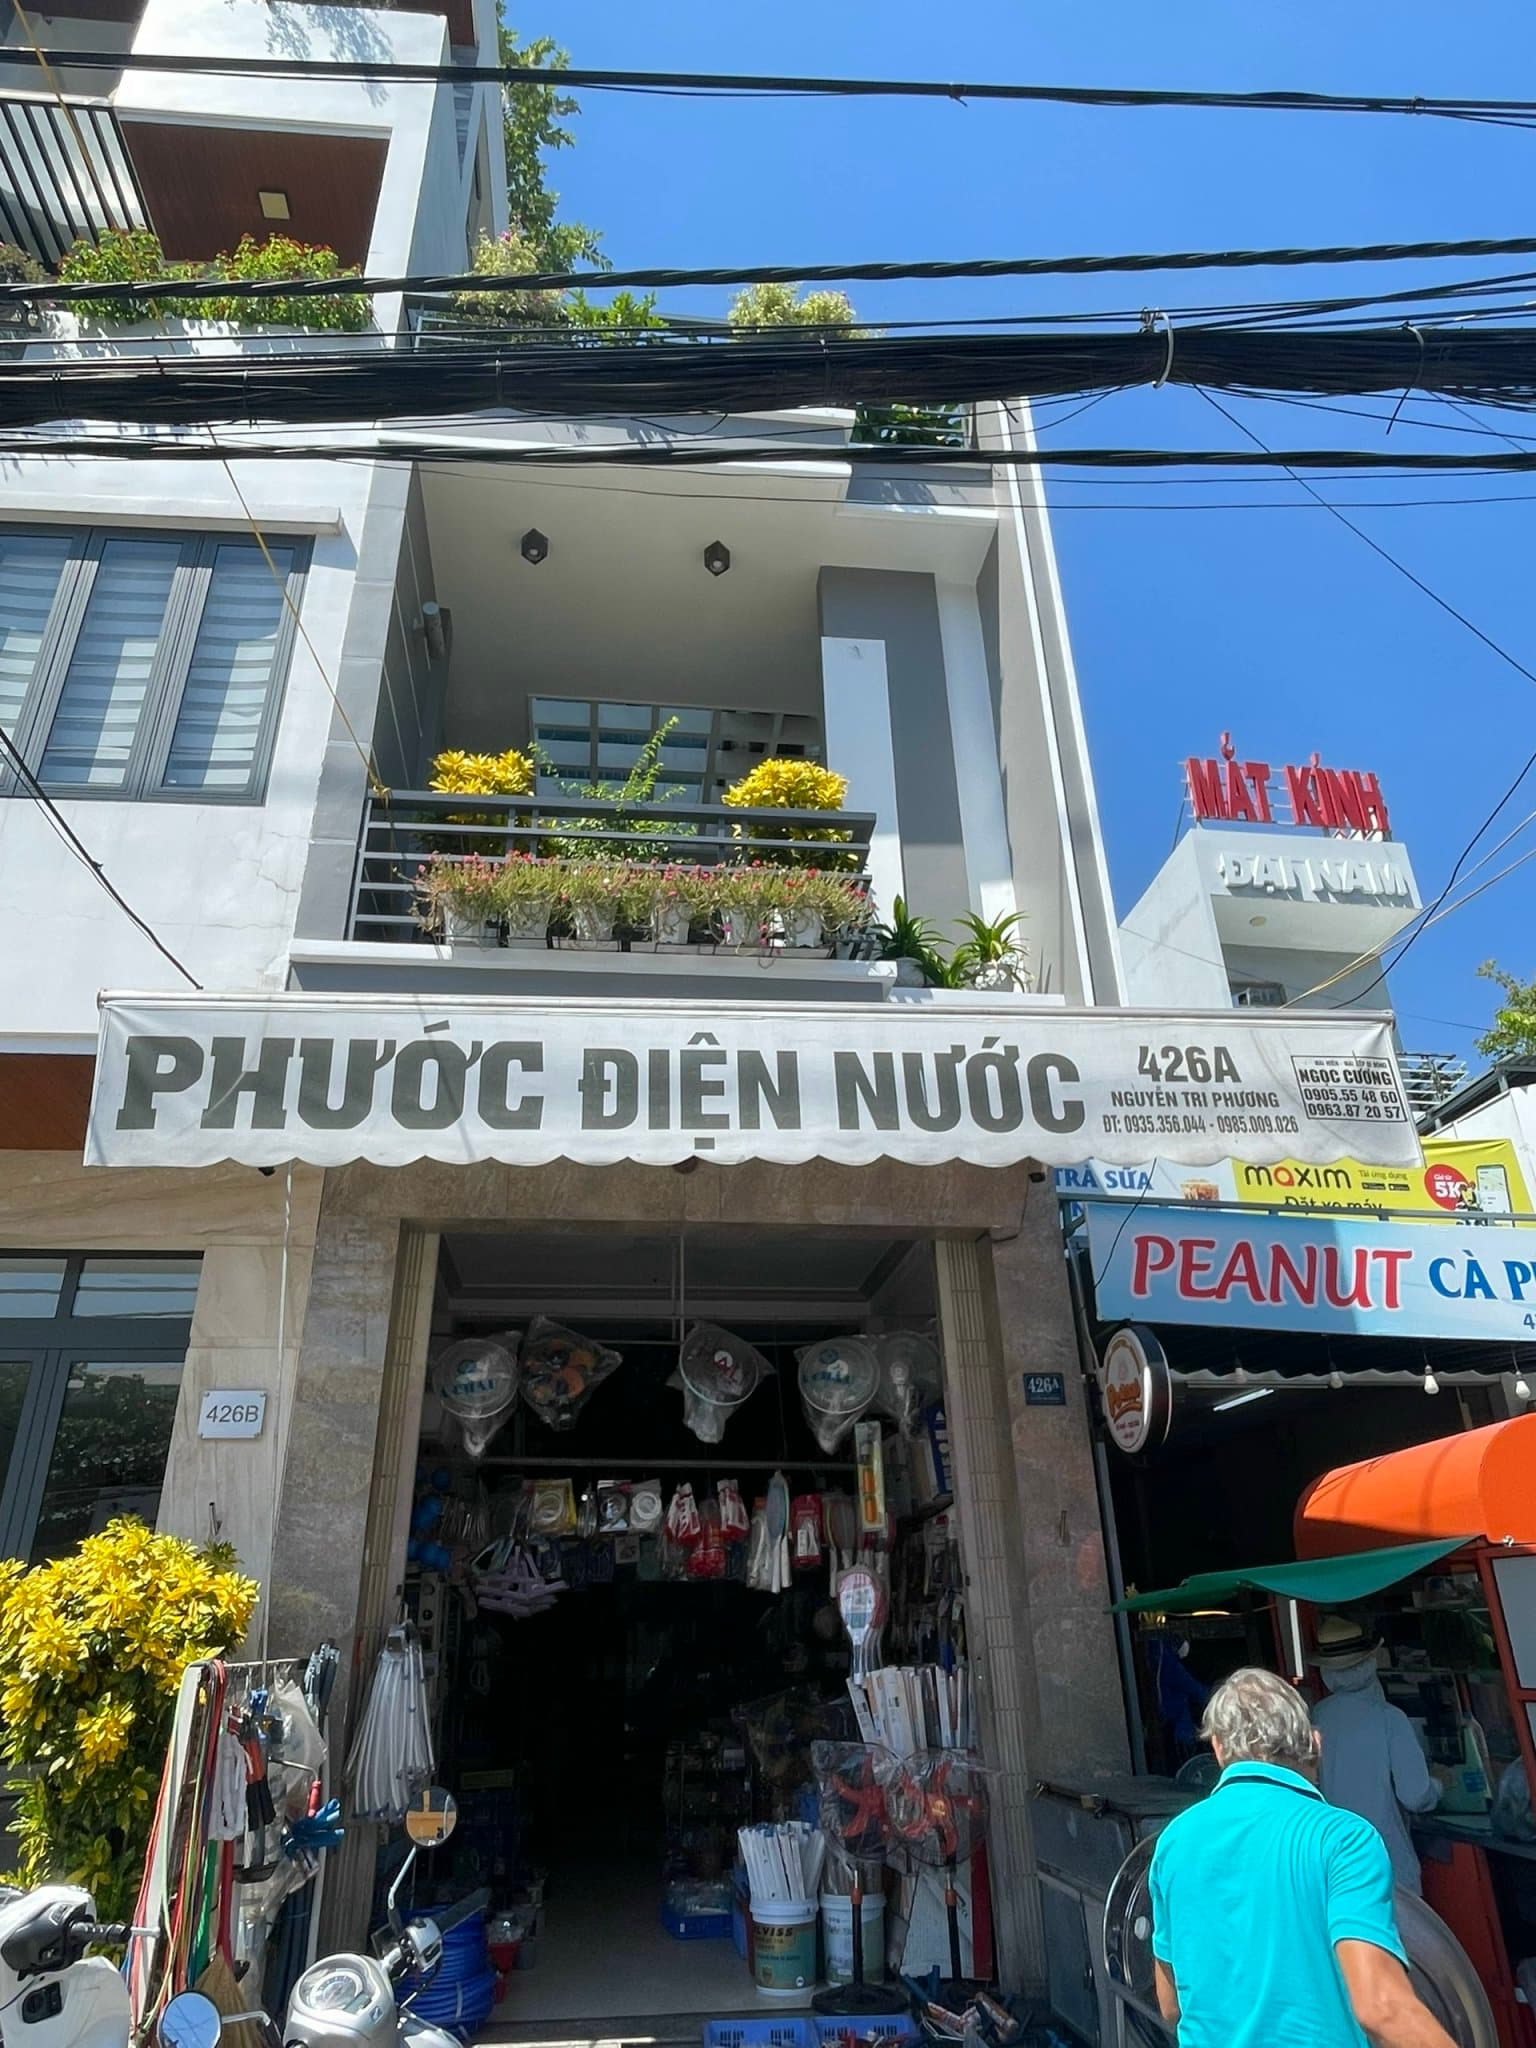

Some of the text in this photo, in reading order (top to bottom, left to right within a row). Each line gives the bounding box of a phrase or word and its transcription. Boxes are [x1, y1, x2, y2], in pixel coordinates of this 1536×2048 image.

[1286, 752, 1389, 830] KÍNH
[1304, 858, 1408, 896] NAM
[1137, 1045, 1242, 1083] 426A
[115, 1020, 1086, 1150] PHƯỚC ĐIỆN NƯỚC
[1298, 1068, 1340, 1087] NGỌC
[1181, 1091, 1208, 1107] TRI
[1212, 1091, 1280, 1108] PHƯƠNG
[1303, 1087, 1398, 1104] 0905.55 48 60
[1308, 1103, 1401, 1119] 0963.87 20 57
[1103, 1114, 1122, 1133] ĐT:
[1124, 1115, 1206, 1133] 0935.356.044
[1217, 1115, 1299, 1134] 0985.009.026
[1132, 1235, 1413, 1310] PEANUT
[1428, 1250, 1498, 1301] CÀ
[1027, 1376, 1059, 1393] 426A
[206, 1404, 259, 1423] 426B
